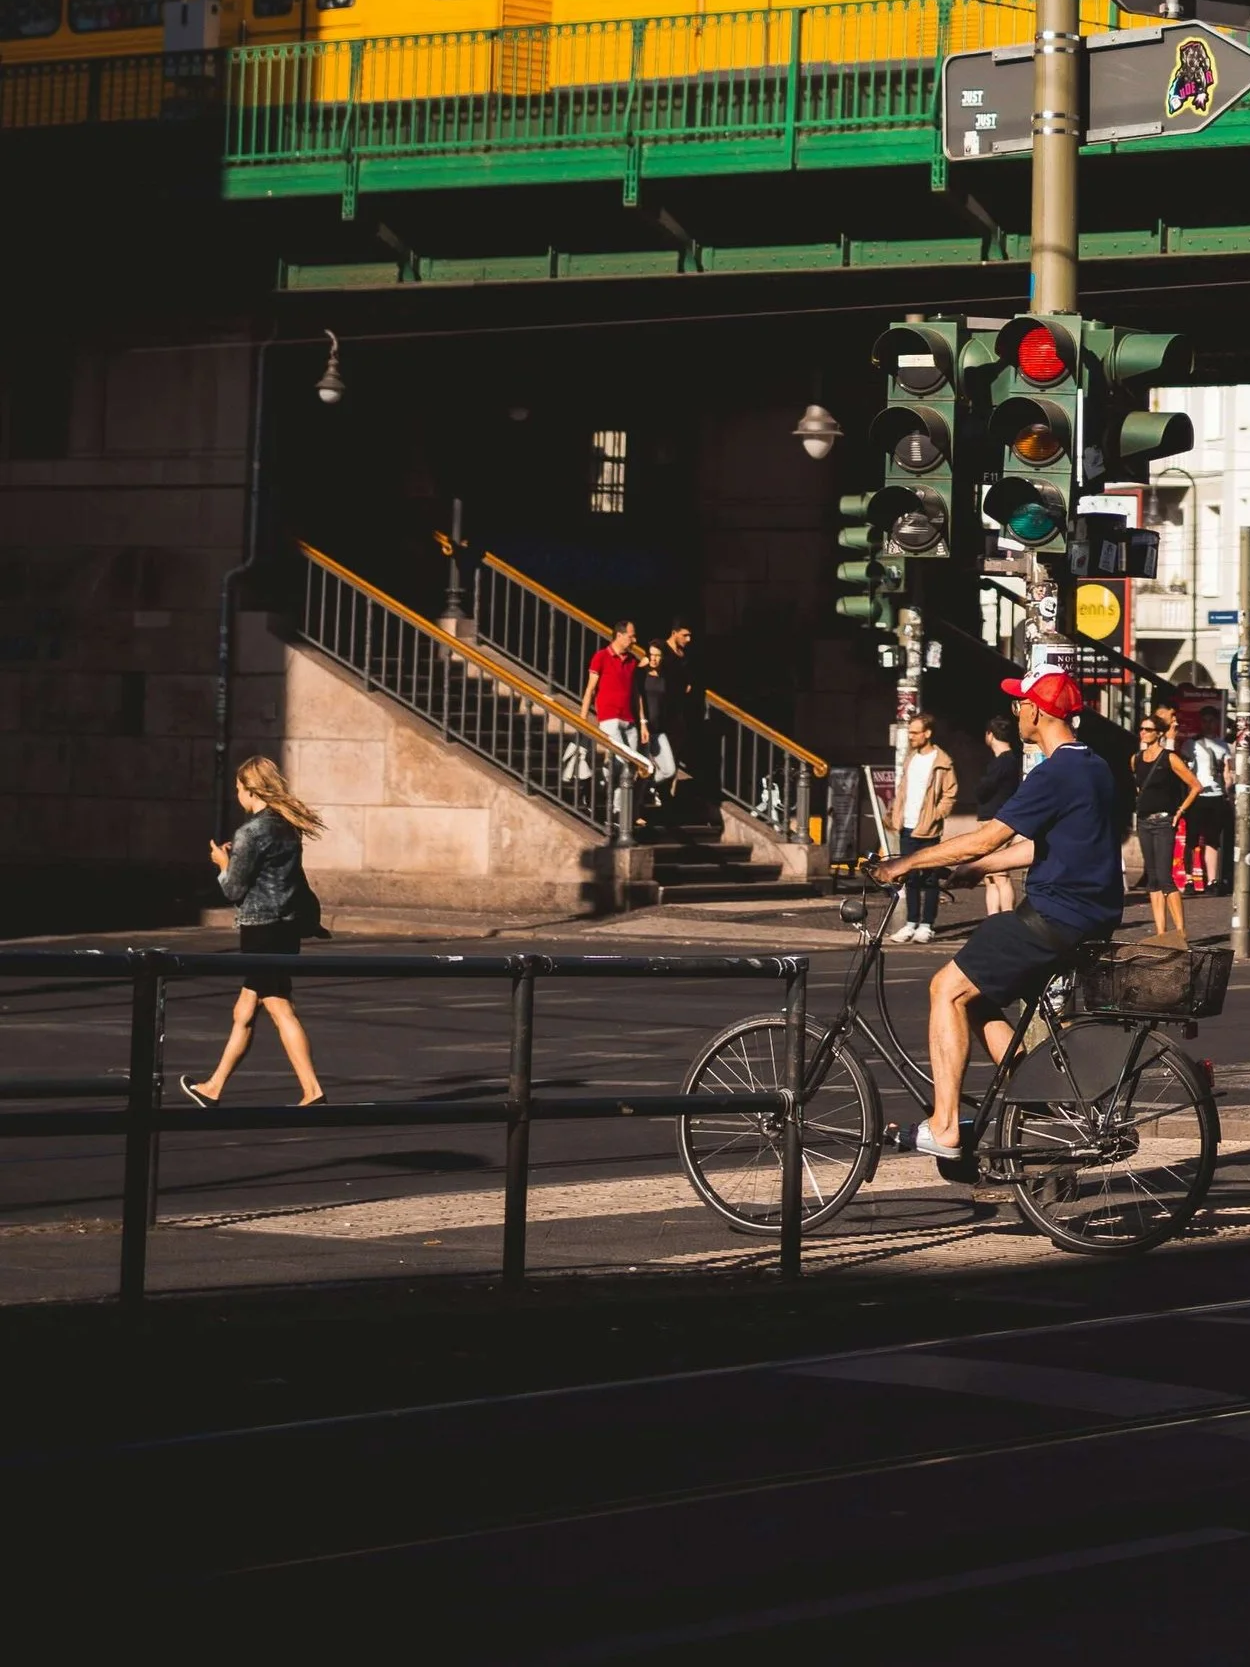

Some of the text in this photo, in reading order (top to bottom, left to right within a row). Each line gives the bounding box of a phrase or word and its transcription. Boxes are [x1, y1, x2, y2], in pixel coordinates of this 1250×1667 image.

[962, 90, 984, 104] JUST
[975, 113, 998, 127] JUST
[983, 471, 998, 481] F11
